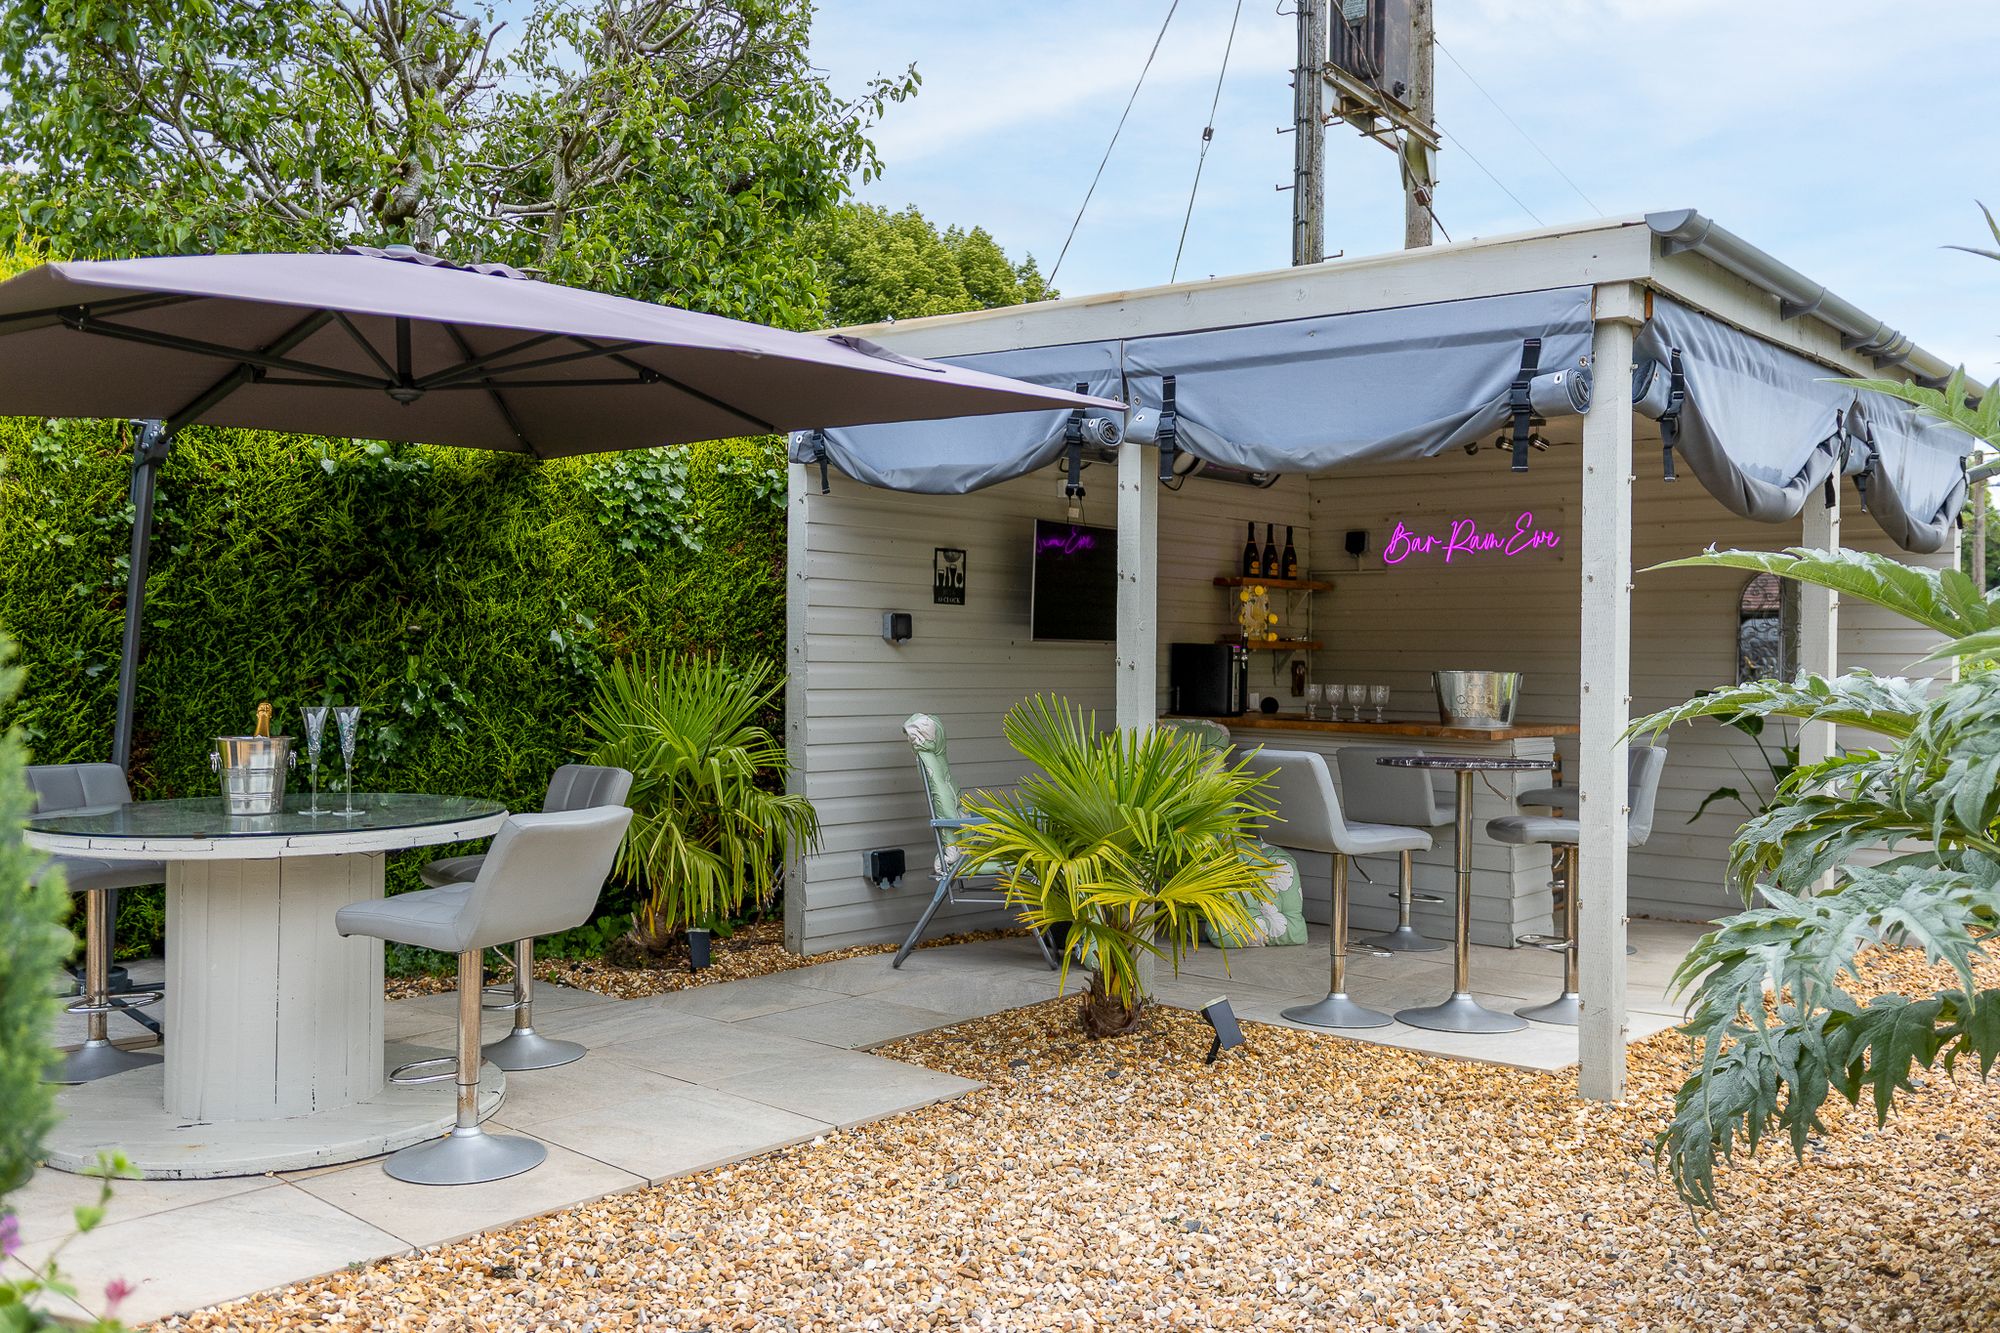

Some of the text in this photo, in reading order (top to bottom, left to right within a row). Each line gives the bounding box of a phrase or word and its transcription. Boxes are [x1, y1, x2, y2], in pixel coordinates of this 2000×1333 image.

[1383, 510, 1561, 564] Bar Ram Ewe
[1455, 694, 1493, 705] COLD
